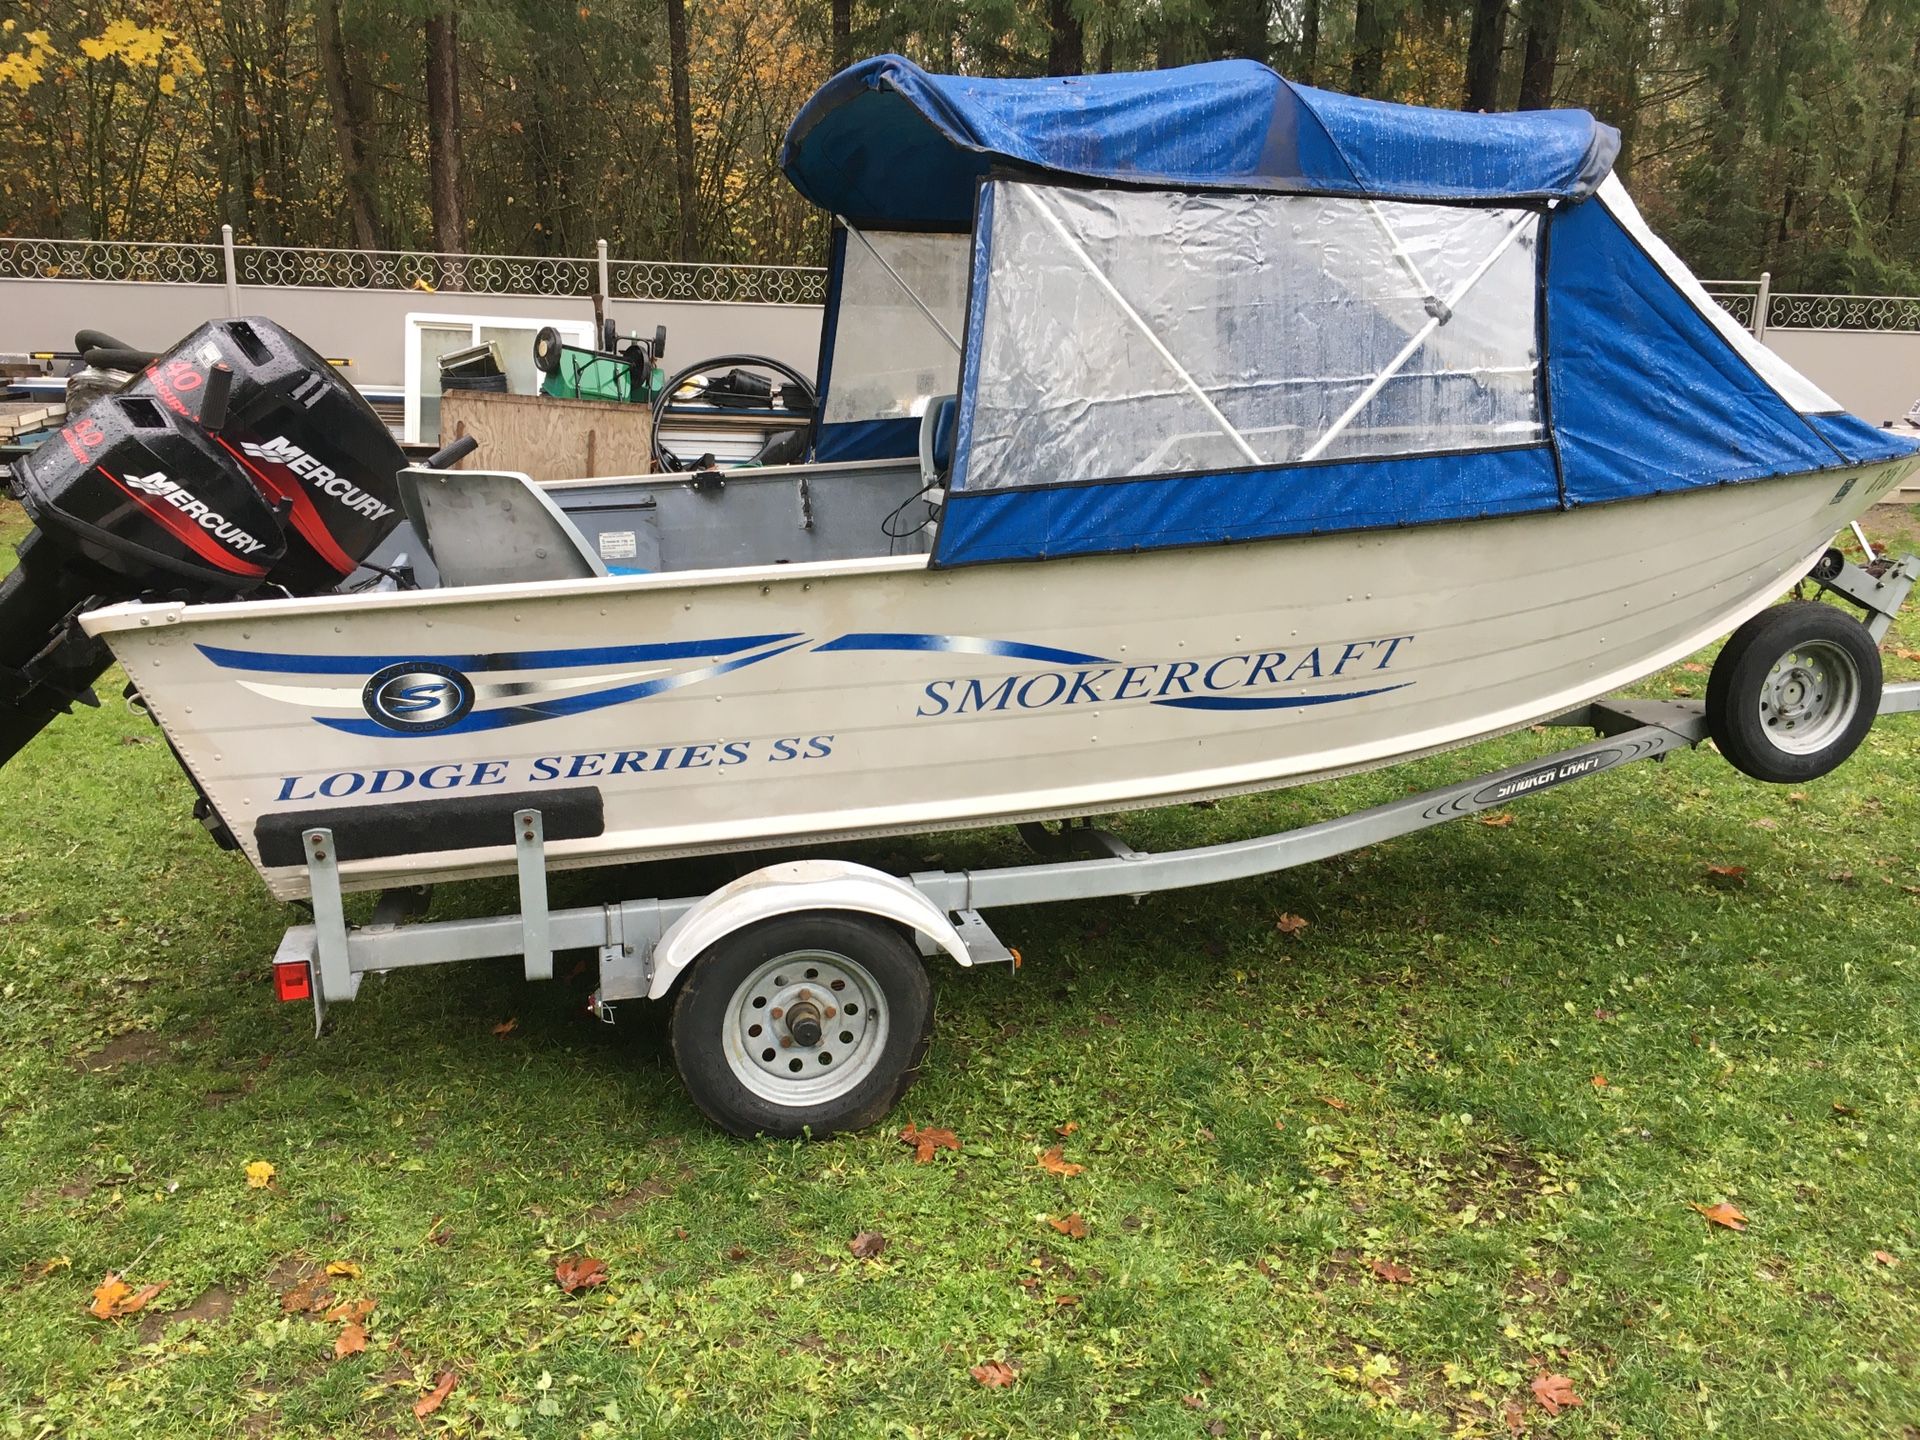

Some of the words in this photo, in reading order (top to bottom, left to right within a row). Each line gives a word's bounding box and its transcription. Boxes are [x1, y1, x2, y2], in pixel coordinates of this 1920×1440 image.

[166, 361, 203, 392] 40
[141, 471, 267, 555] MERCURY
[260, 435, 396, 522] MERCURY
[915, 635, 1415, 718] SMOKERCRAFT
[273, 760, 510, 802] LODGE
[528, 740, 752, 782] SERIES
[768, 734, 835, 763] SS
